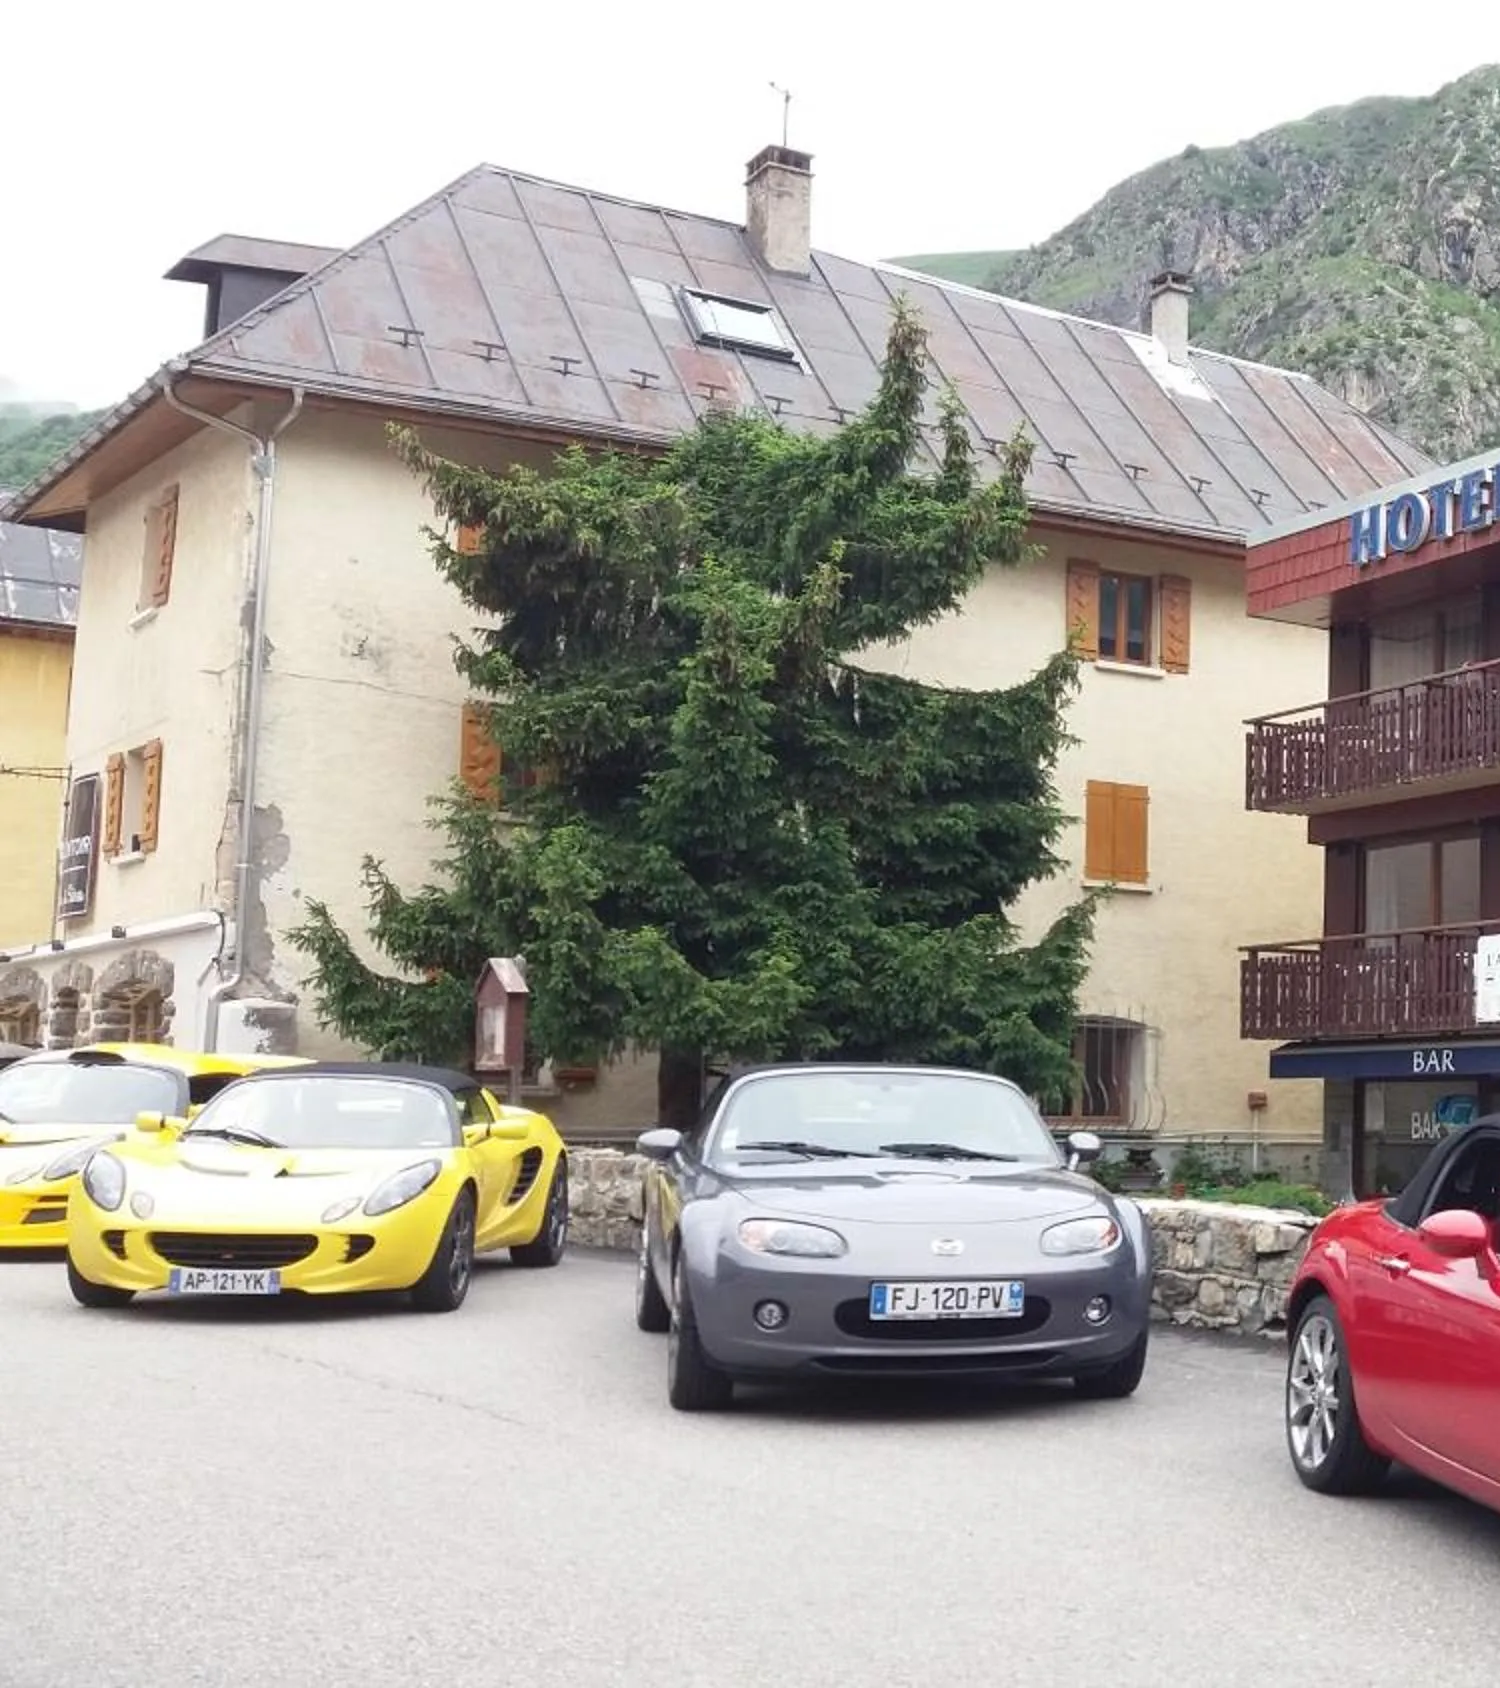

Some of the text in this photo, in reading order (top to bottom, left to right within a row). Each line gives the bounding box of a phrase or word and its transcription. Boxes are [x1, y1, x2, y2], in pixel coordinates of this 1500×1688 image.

[1412, 1049, 1456, 1073] BAR
[183, 1271, 265, 1291] AP-121-YK
[891, 1286, 1004, 1311] FJ-120-PV
